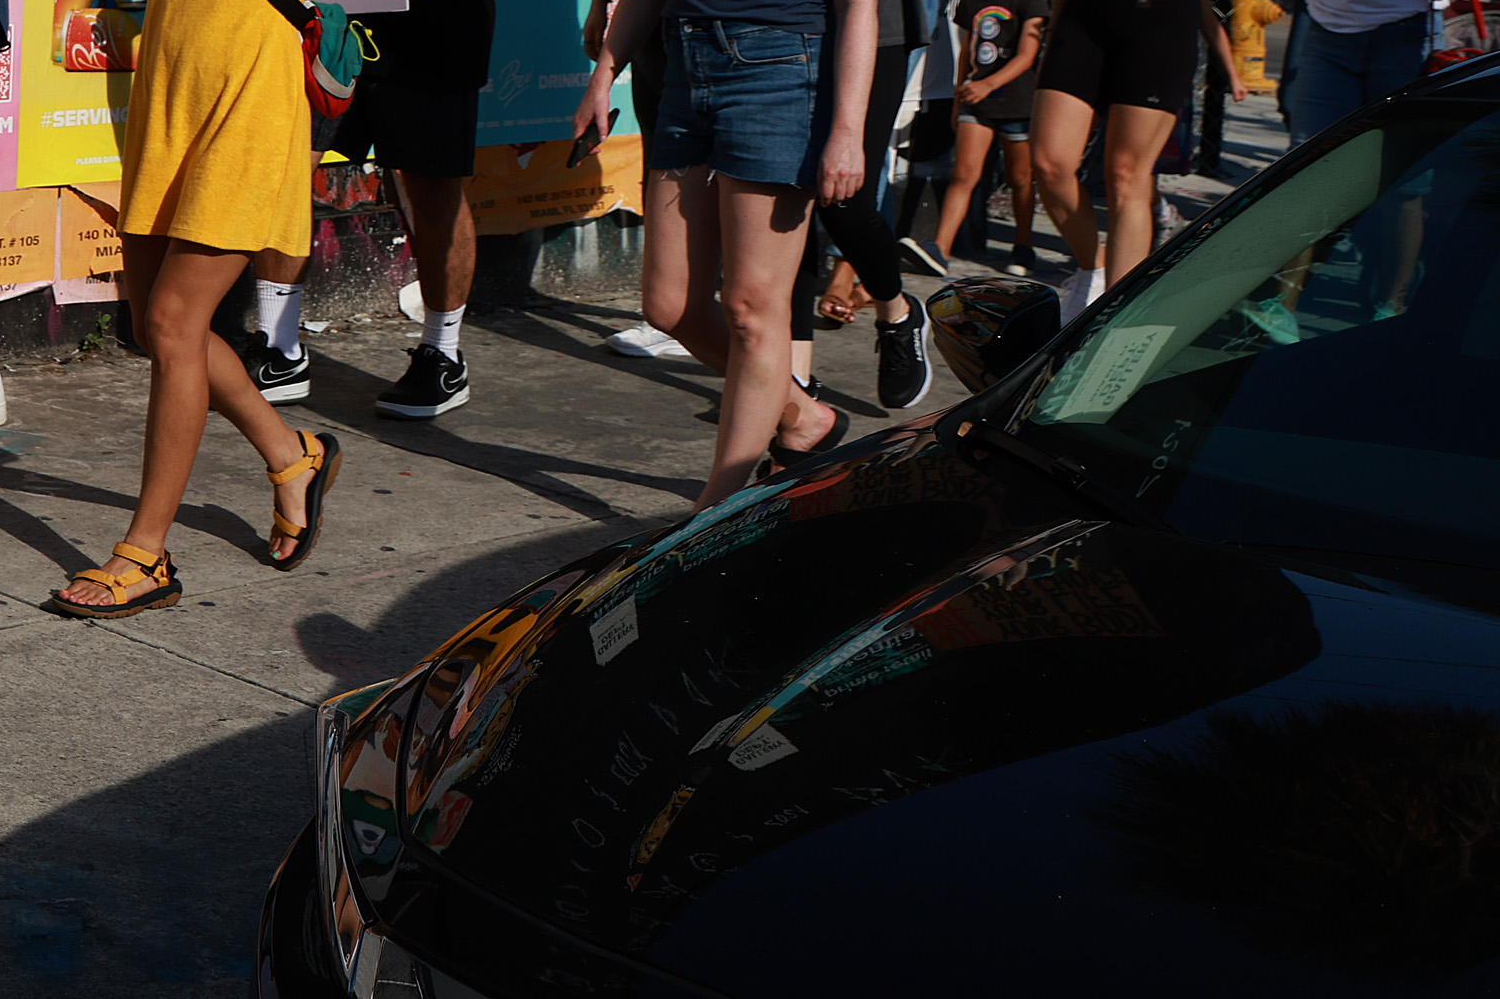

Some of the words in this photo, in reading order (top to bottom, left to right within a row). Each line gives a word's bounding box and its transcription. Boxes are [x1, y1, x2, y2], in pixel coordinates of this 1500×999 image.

[9, 238, 17, 248] #
[20, 235, 40, 248] 105
[78, 230, 100, 242] 140
